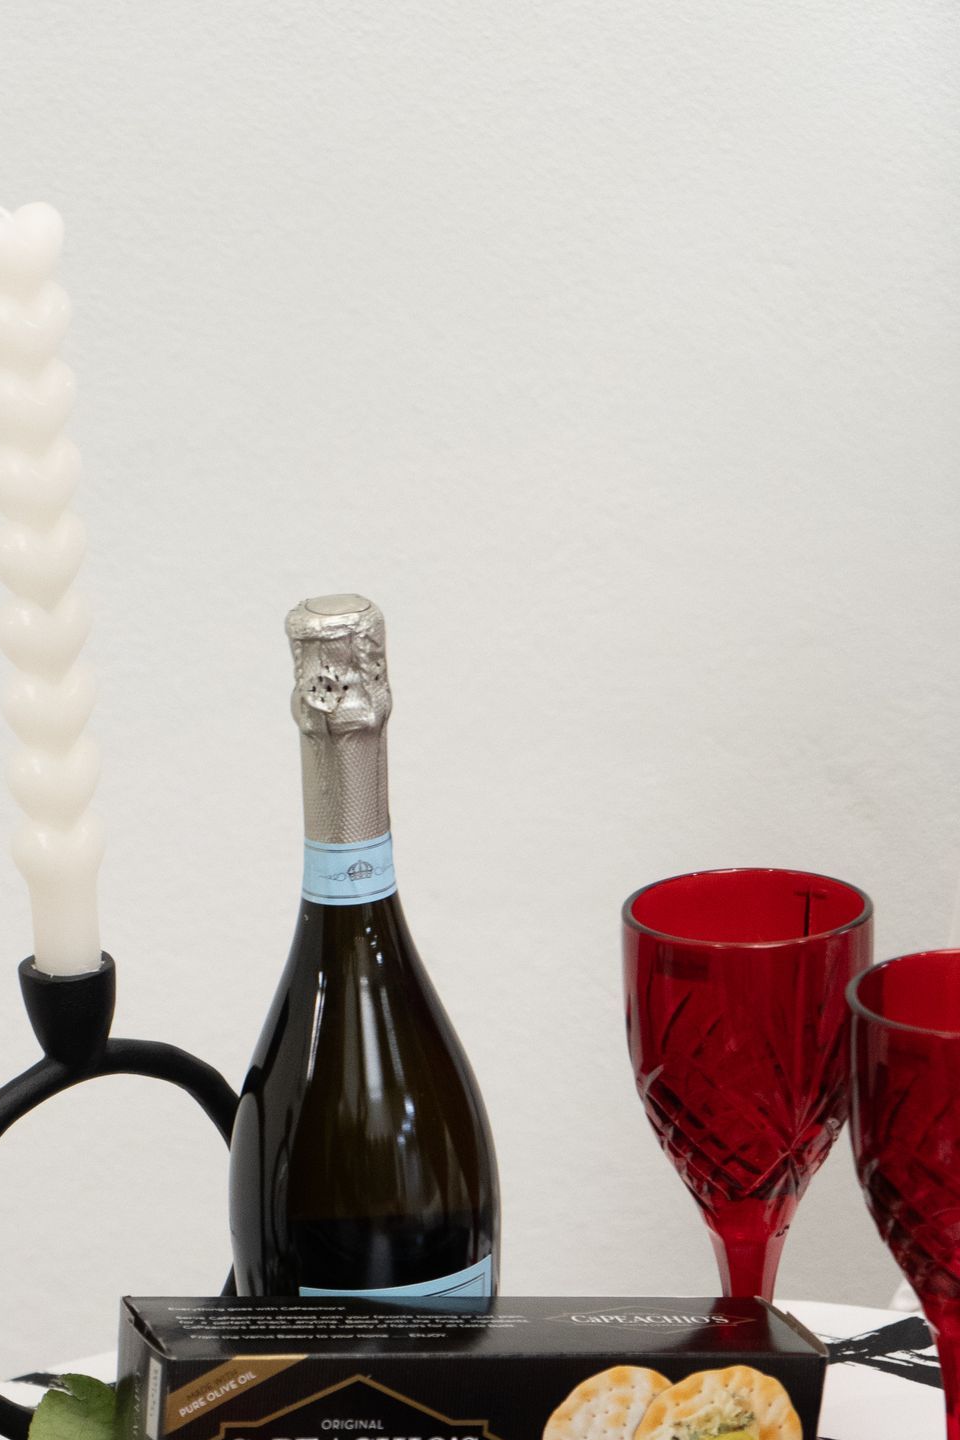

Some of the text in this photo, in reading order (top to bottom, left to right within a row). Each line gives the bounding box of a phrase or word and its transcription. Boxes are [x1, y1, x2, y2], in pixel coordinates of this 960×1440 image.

[179, 1371, 257, 1417] PURE OLIVE OIL
[321, 1419, 384, 1430] ORIGINAL
